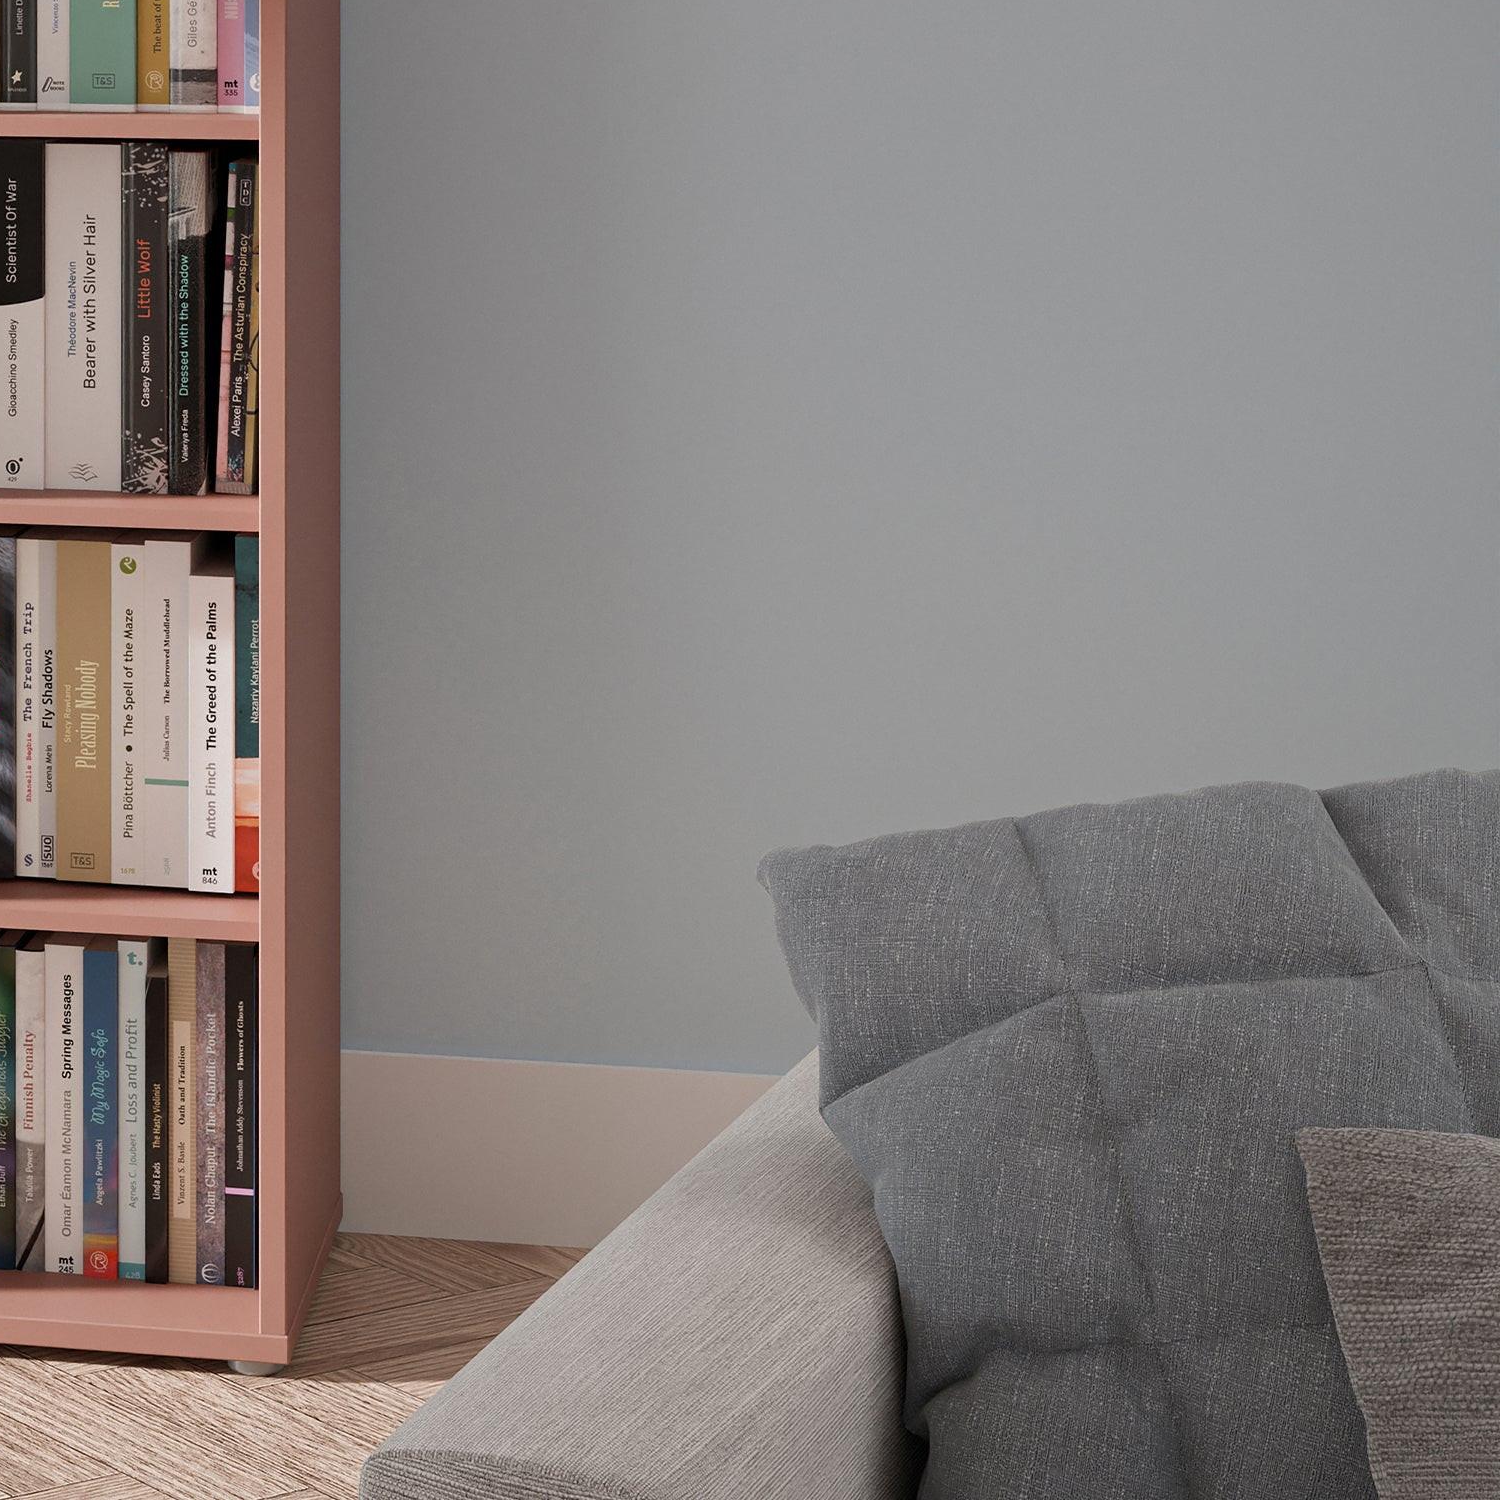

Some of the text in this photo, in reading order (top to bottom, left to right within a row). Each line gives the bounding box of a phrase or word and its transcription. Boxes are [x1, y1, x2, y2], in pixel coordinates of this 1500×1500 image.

[15, 8, 24, 34] Linette
[95, 76, 112, 85] T&S
[5, 179, 17, 282] Scientist Of War
[136, 240, 151, 317] Little Wolf
[83, 215, 96, 388] Bearer with Silver Hair
[178, 255, 189, 395] Dressed with the Shadow
[7, 319, 19, 416] Gioacchino Smedley
[140, 336, 152, 406] Casey Santoro
[22, 603, 35, 721] The French Trip
[41, 650, 56, 728] Fly Shadows
[122, 609, 136, 736] The Spell of the Maze
[205, 603, 217, 750] The Greed of the Palms
[74, 660, 100, 768] Pleasing Nobody
[42, 837, 53, 860] SUO
[122, 762, 134, 838] Pina Böttcher
[205, 763, 217, 838] Anton Finch
[61, 975, 74, 1078] Spring Messages
[124, 1019, 138, 1122] Loss and Profit
[22, 1031, 37, 1129] Finnish Penalty
[177, 1046, 186, 1125] Oath and Tradition
[59, 1091, 72, 1236] Omar Éamon McNamara
